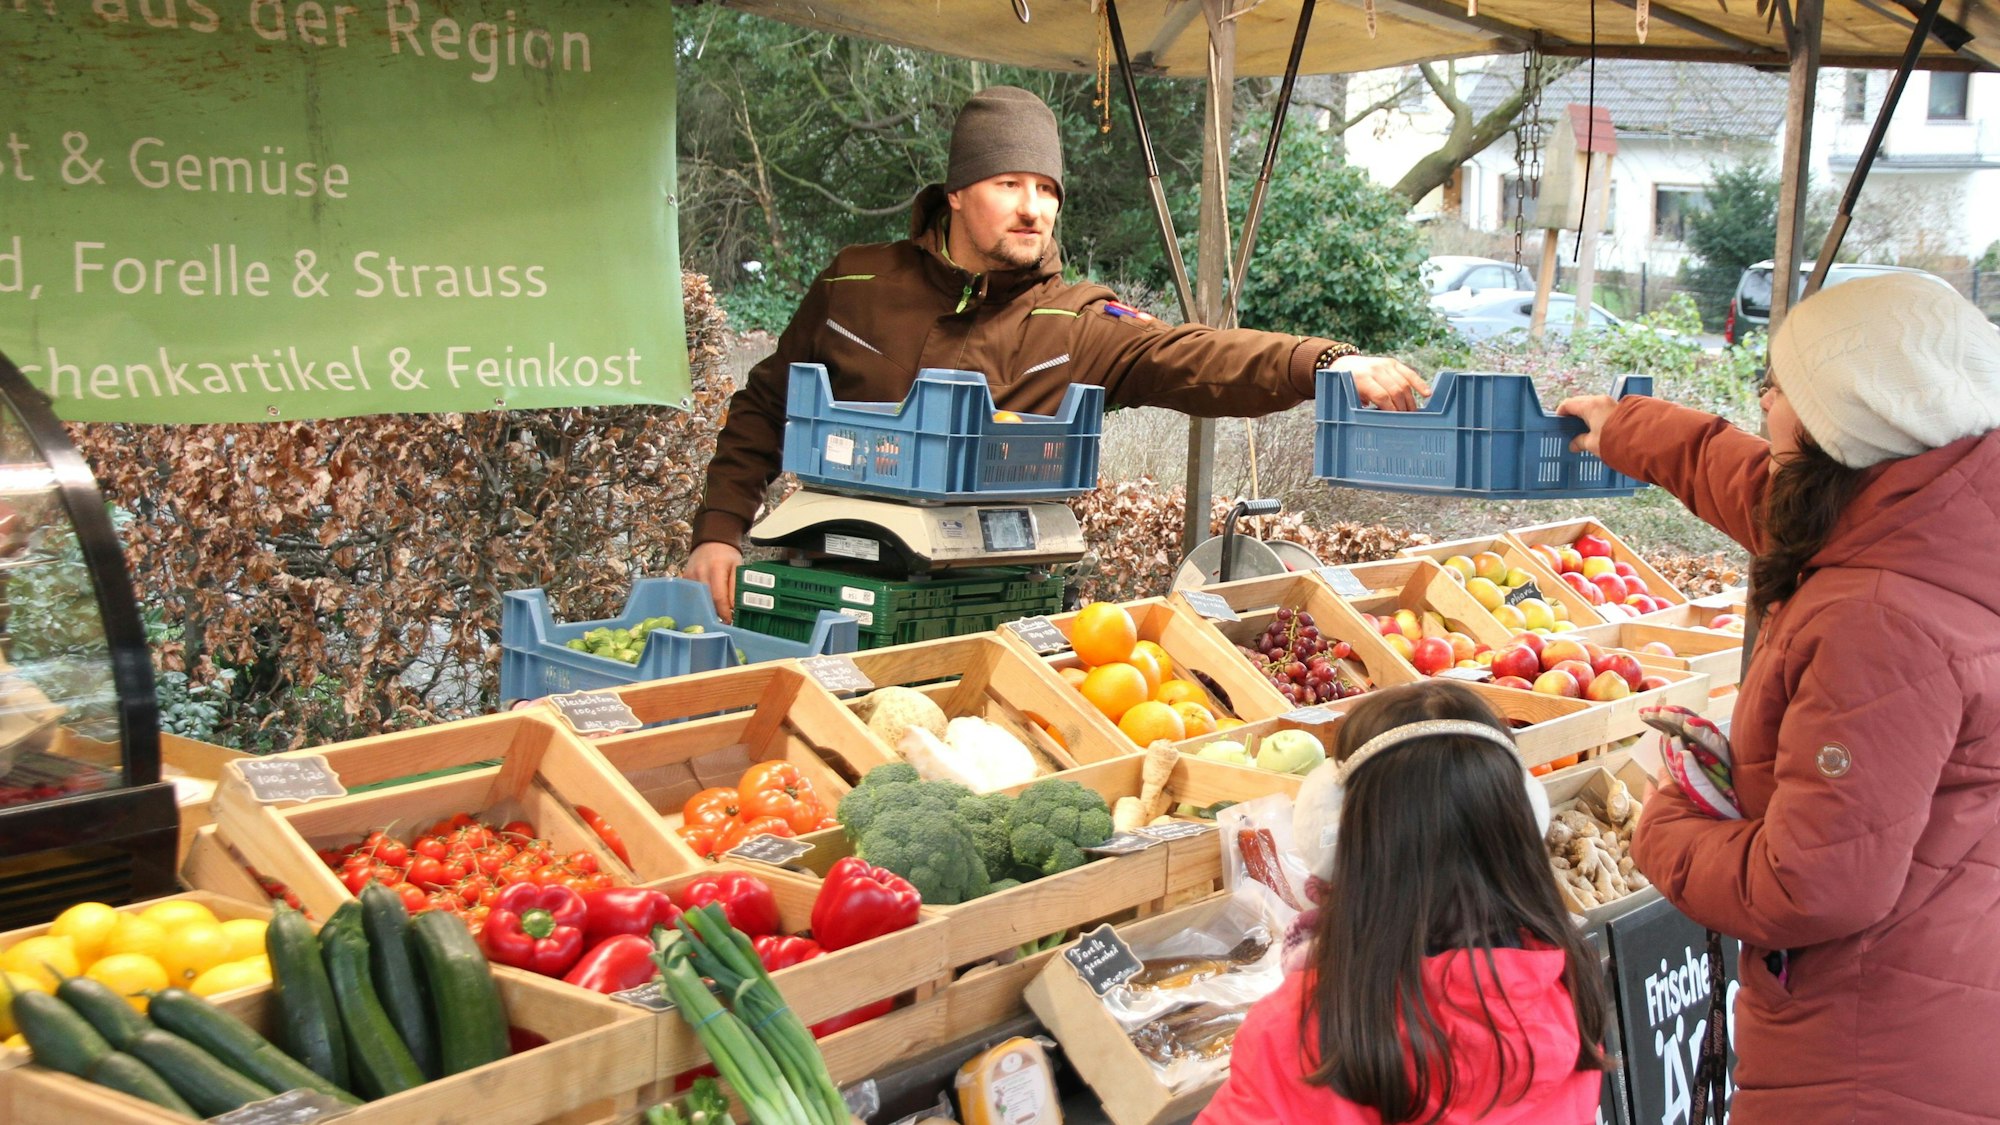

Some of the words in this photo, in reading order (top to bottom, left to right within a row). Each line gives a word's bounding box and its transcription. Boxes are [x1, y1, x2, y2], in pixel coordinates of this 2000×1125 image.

[250, 0, 349, 48] der
[388, 11, 592, 83] Region
[60, 130, 106, 185] &
[129, 137, 349, 199] Gemüse
[74, 241, 270, 298] Forelle
[292, 249, 329, 298] &
[354, 250, 548, 298] Strauss
[388, 346, 429, 391] &
[446, 342, 642, 388] Feinkost
[1644, 945, 1712, 1027] Frische
